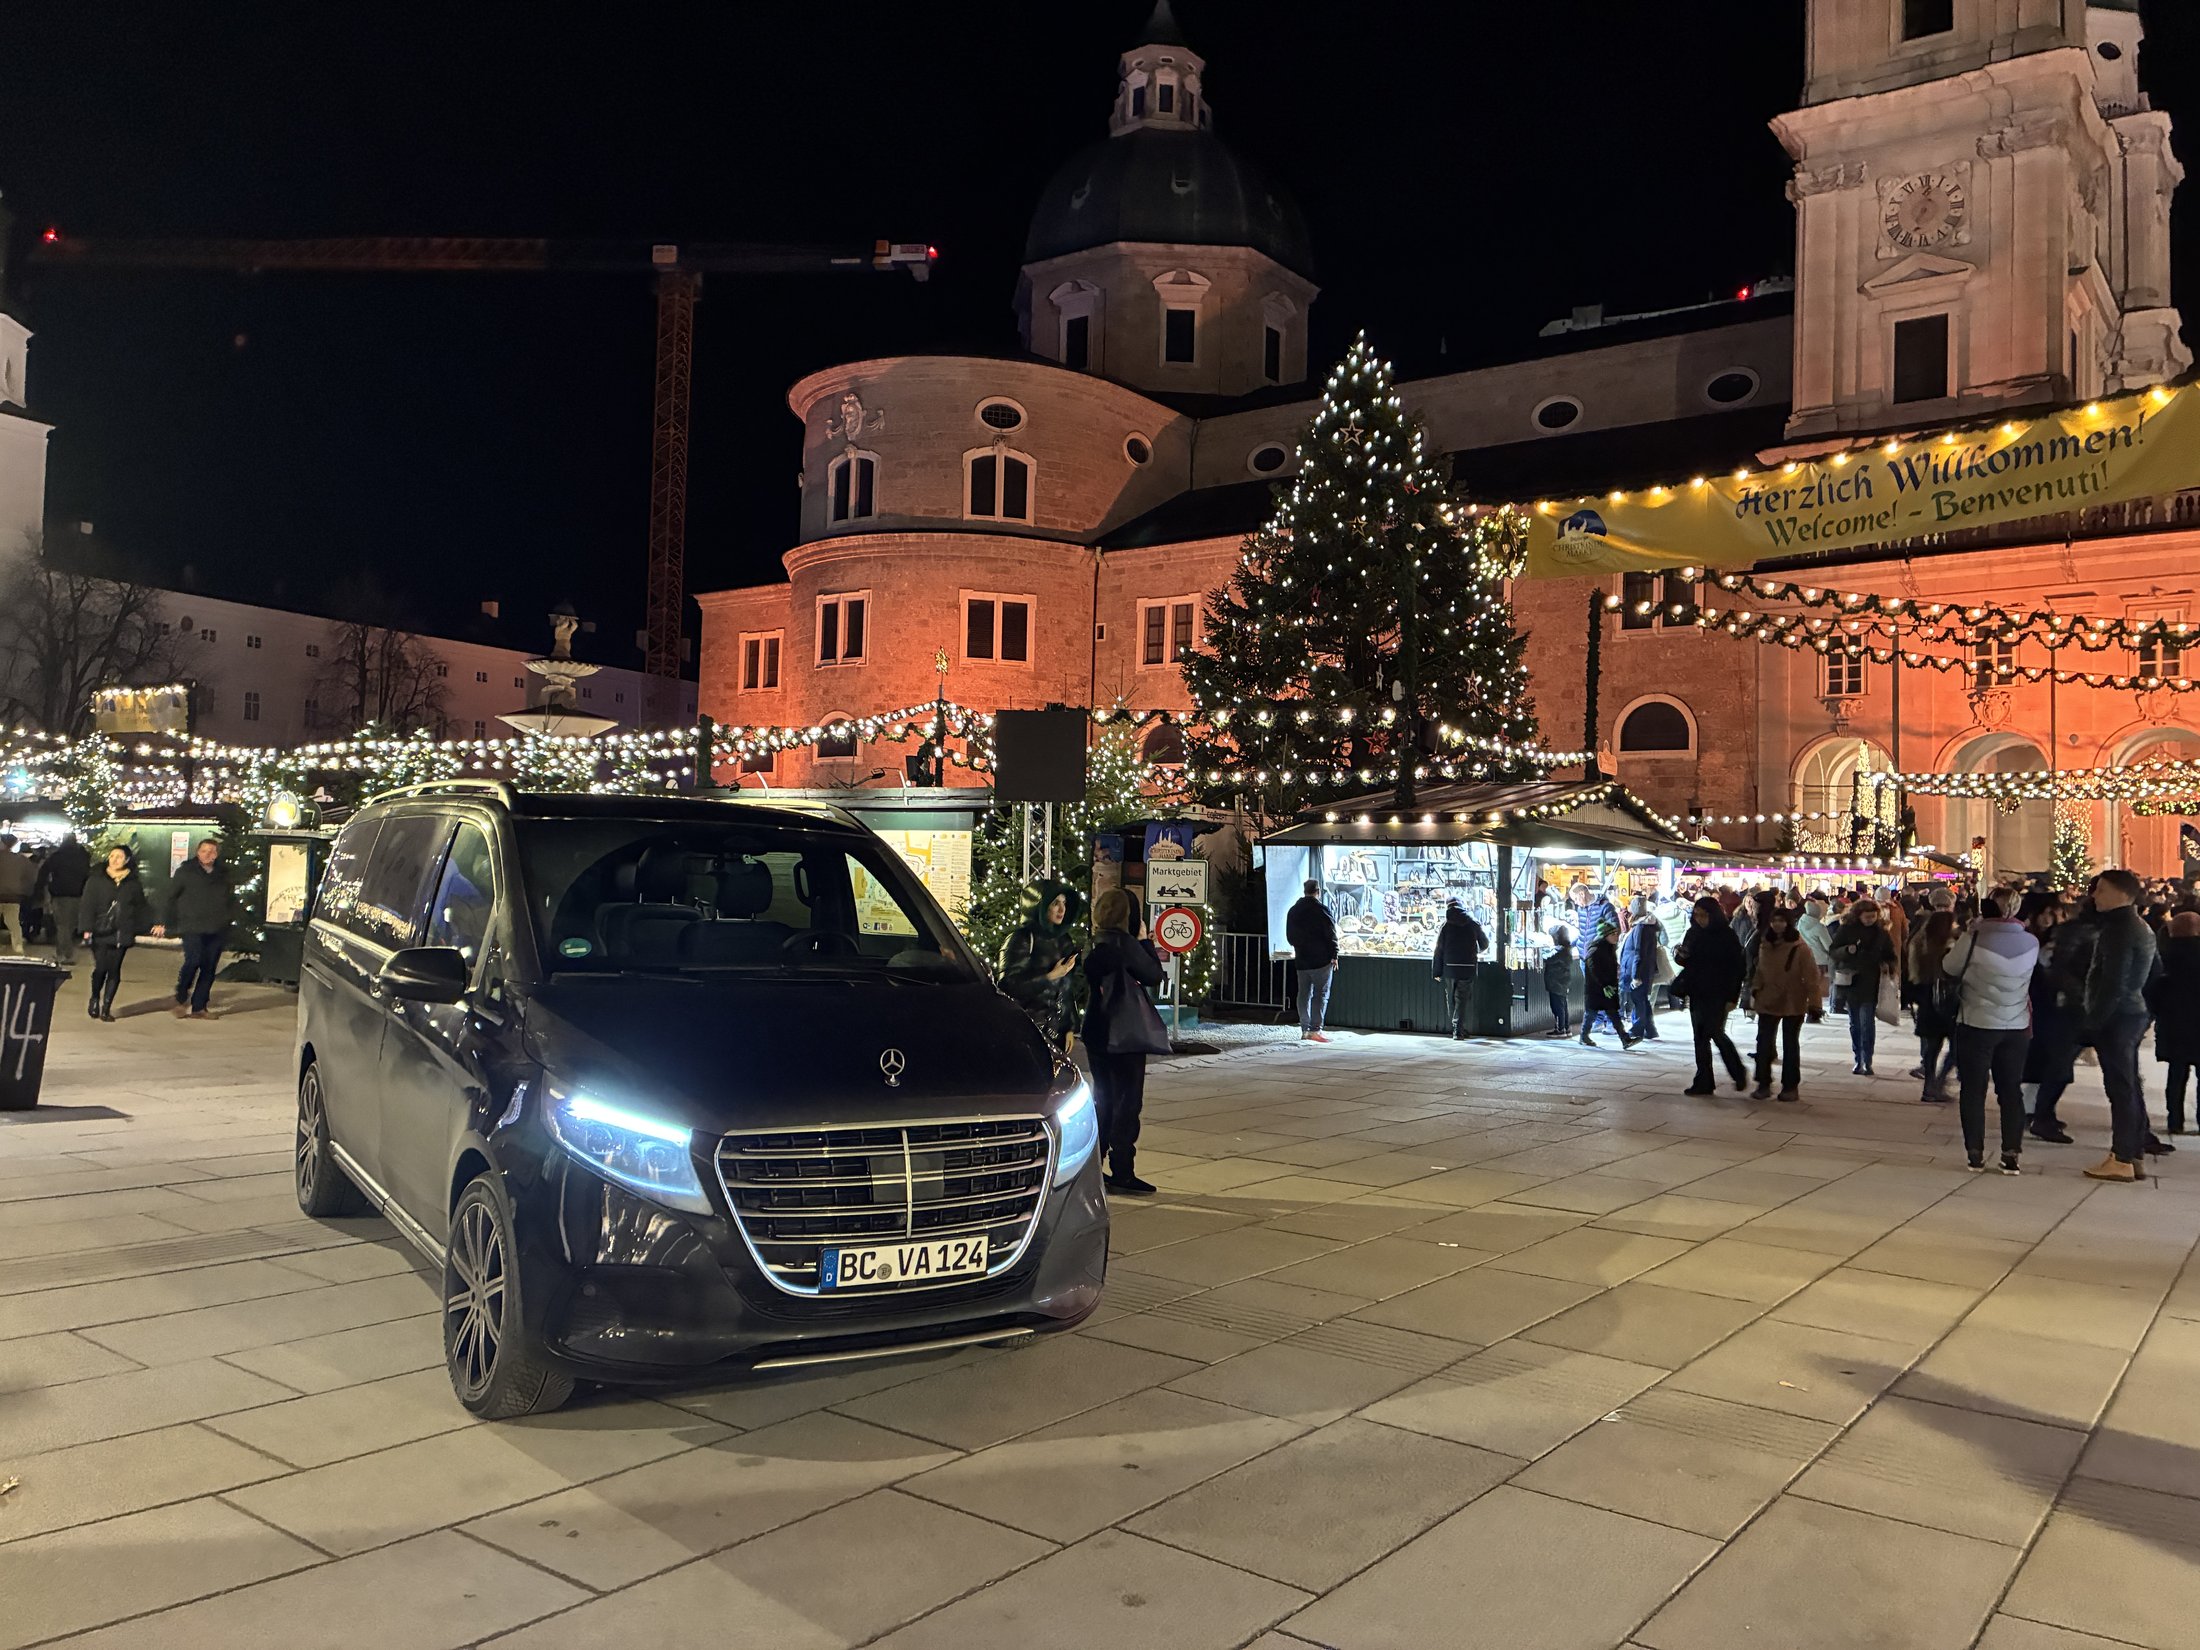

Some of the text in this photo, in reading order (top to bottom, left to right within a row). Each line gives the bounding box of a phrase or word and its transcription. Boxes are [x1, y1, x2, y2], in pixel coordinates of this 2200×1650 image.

[1736, 410, 2145, 519] Herzlich Willkommen!
[1765, 499, 1898, 547] Welcome!
[1931, 460, 2109, 521] Benvenuti!
[1152, 867, 1202, 877] Marktgebiet
[826, 1273, 833, 1282] D
[839, 1251, 876, 1282] BC
